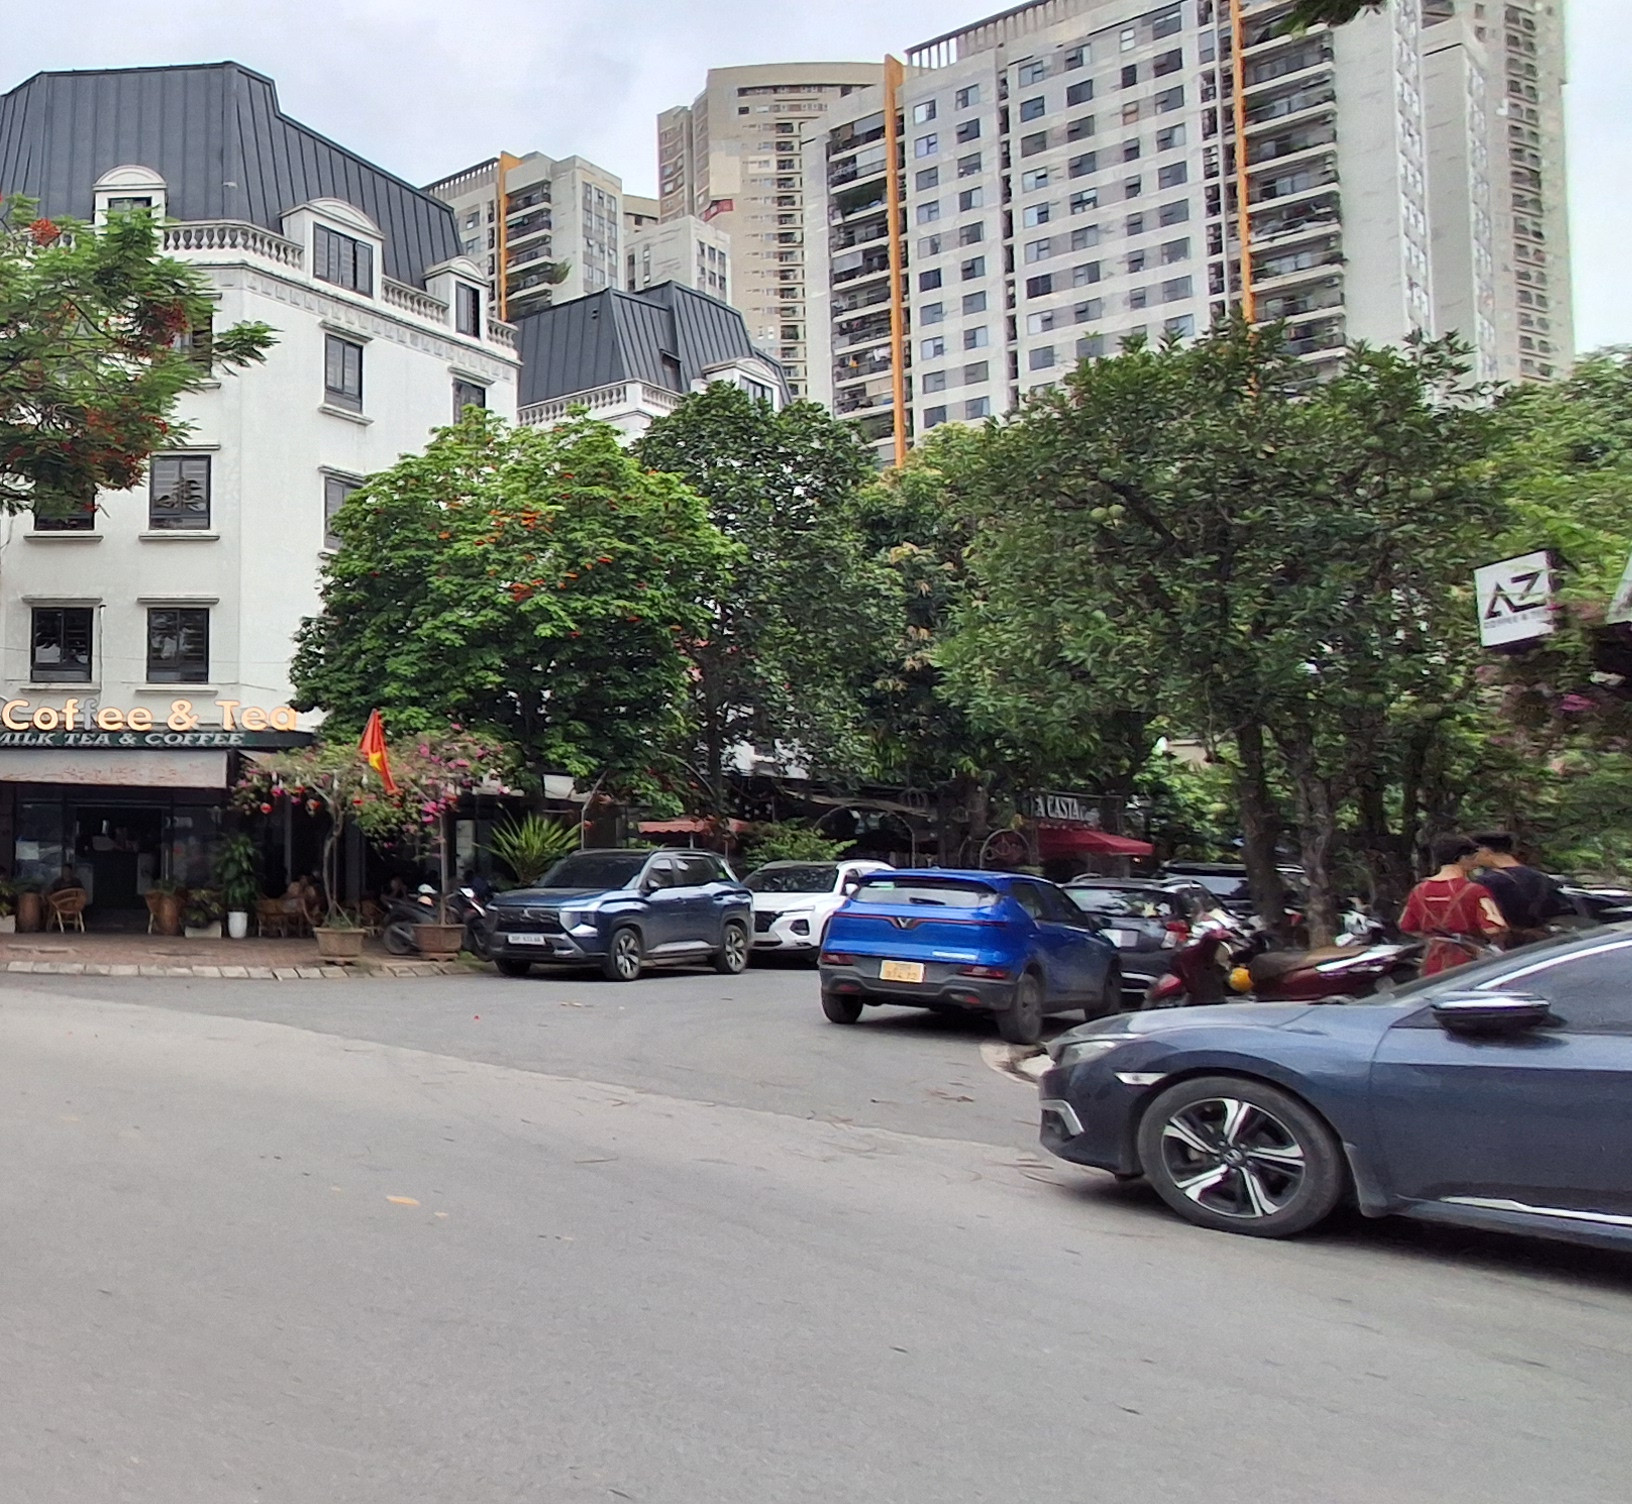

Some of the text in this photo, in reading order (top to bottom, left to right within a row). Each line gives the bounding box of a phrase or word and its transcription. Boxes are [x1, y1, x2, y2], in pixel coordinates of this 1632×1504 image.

[1, 697, 297, 732] Coffee & Tea
[63, 732, 111, 746] TEA
[118, 732, 137, 746] &
[145, 732, 246, 746] COFFEE
